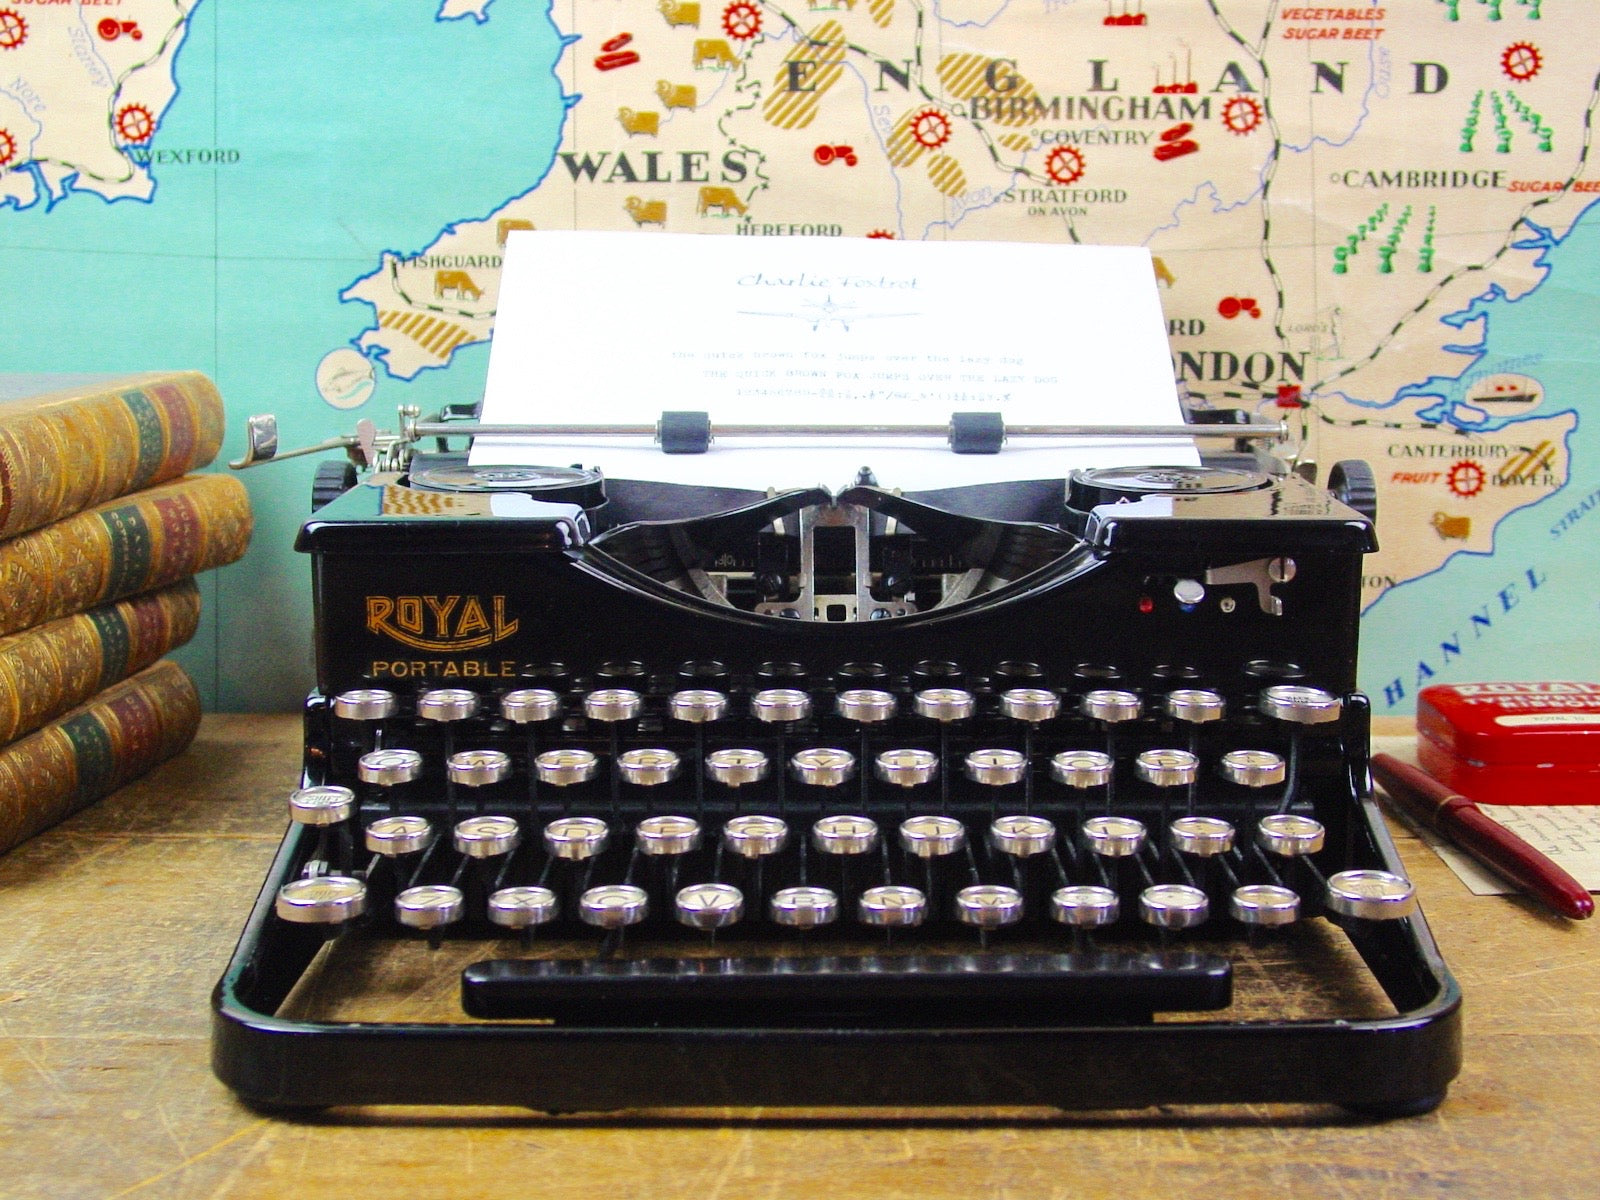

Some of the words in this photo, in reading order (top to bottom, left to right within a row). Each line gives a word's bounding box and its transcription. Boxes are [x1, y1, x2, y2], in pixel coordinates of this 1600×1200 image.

[1283, 28, 1339, 40] SUGAR
[1342, 28, 1386, 40] BEET
[969, 95, 1213, 121] BIRMINGHAM
[1040, 129, 1154, 146] COVENTRY
[136, 149, 241, 165] WEXFORD
[559, 150, 749, 184] WALES
[1343, 169, 1508, 190] CAMBRIDGE
[1508, 180, 1564, 193] SUGAR
[1004, 188, 1127, 204] STRATFORD
[1028, 205, 1046, 217] ON
[1051, 205, 1088, 217] AVON
[735, 223, 843, 237] HEREFORD
[737, 273, 831, 288] Charlie
[839, 275, 921, 290] Foxtrot
[1172, 351, 1312, 382] NDON
[1388, 444, 1510, 459] CANTERBURY
[1390, 471, 1443, 485] FRUIT
[365, 594, 519, 652] ROYAL
[372, 660, 517, 678] PORTABLE
